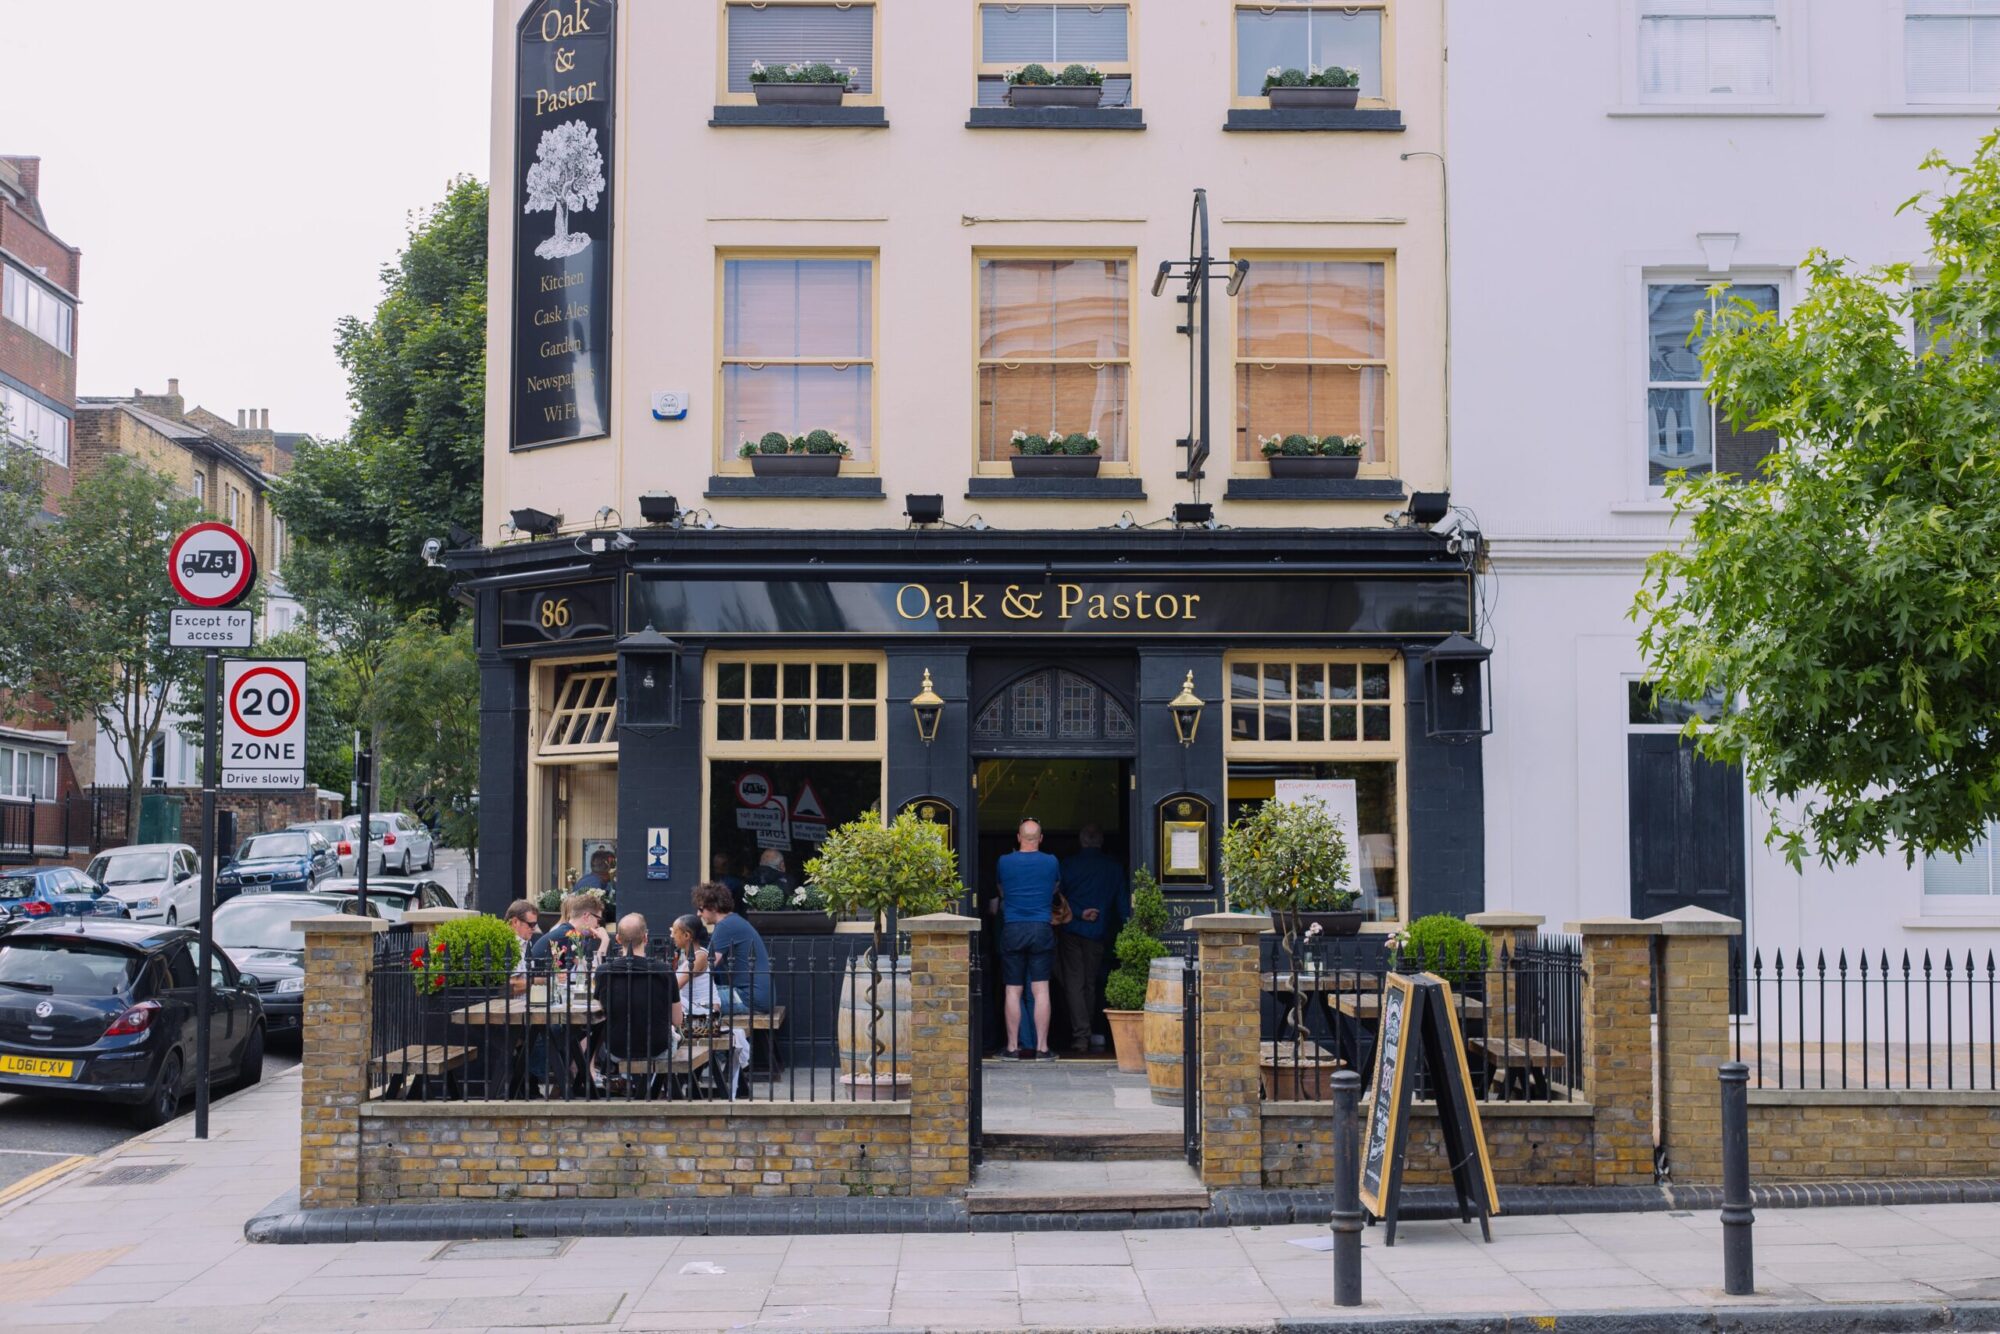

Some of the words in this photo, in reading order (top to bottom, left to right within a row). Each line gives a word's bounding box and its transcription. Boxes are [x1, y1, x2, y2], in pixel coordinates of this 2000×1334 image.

[542, 0, 590, 42] Oak
[555, 47, 576, 73] &
[536, 81, 597, 116] Pastor
[541, 271, 584, 292] Kitchen
[534, 305, 562, 326] Cask
[564, 301, 589, 321] Ales
[540, 336, 581, 358] Garden
[527, 367, 595, 393] Newspaprs
[896, 581, 987, 619] Oak
[1001, 585, 1043, 619] &
[1057, 584, 1200, 619] Pastor
[175, 615, 221, 628] Except
[228, 616, 246, 627] for
[542, 599, 569, 628] 86
[187, 631, 233, 641] access
[242, 688, 290, 716] 20
[231, 743, 295, 760] ZONE
[227, 774, 258, 784] Drive
[262, 774, 300, 785] slowly
[1173, 905, 1191, 917] NO
[8, 1058, 37, 1072] LO61
[39, 1060, 65, 1073] CXV
